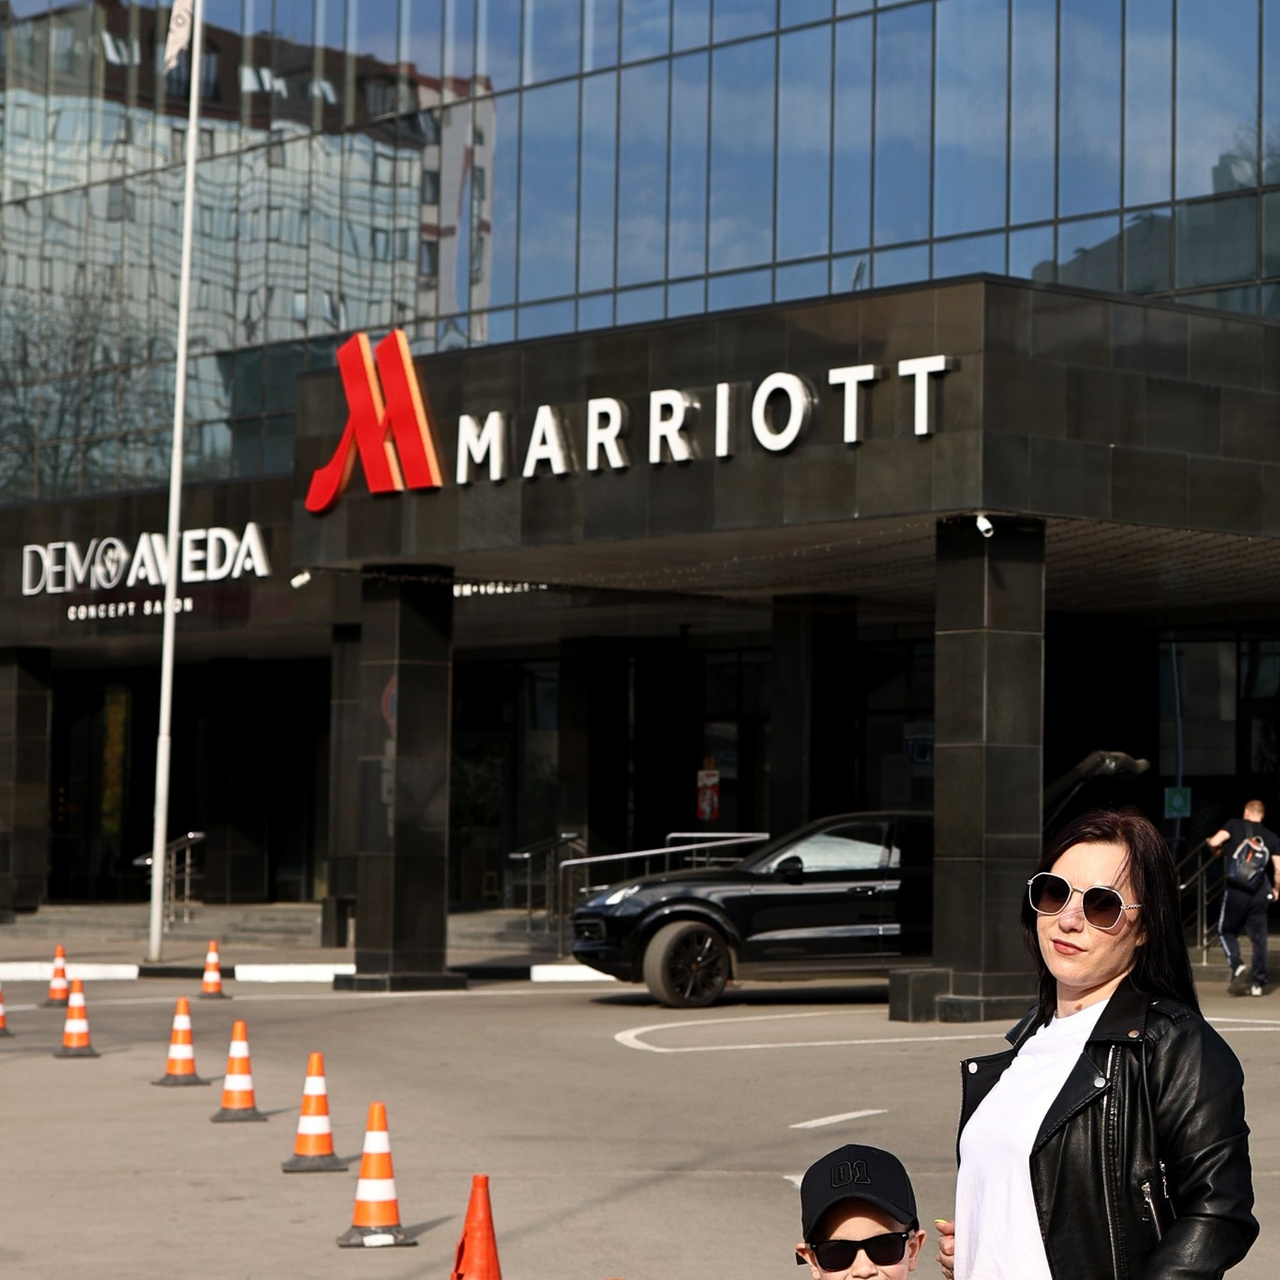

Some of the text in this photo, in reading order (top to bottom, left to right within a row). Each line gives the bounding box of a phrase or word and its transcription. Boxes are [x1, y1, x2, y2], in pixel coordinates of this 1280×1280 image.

[456, 354, 950, 486] MARRIOTT
[67, 597, 194, 621] CONCEPT SAON
[832, 1160, 870, 1187] 01
